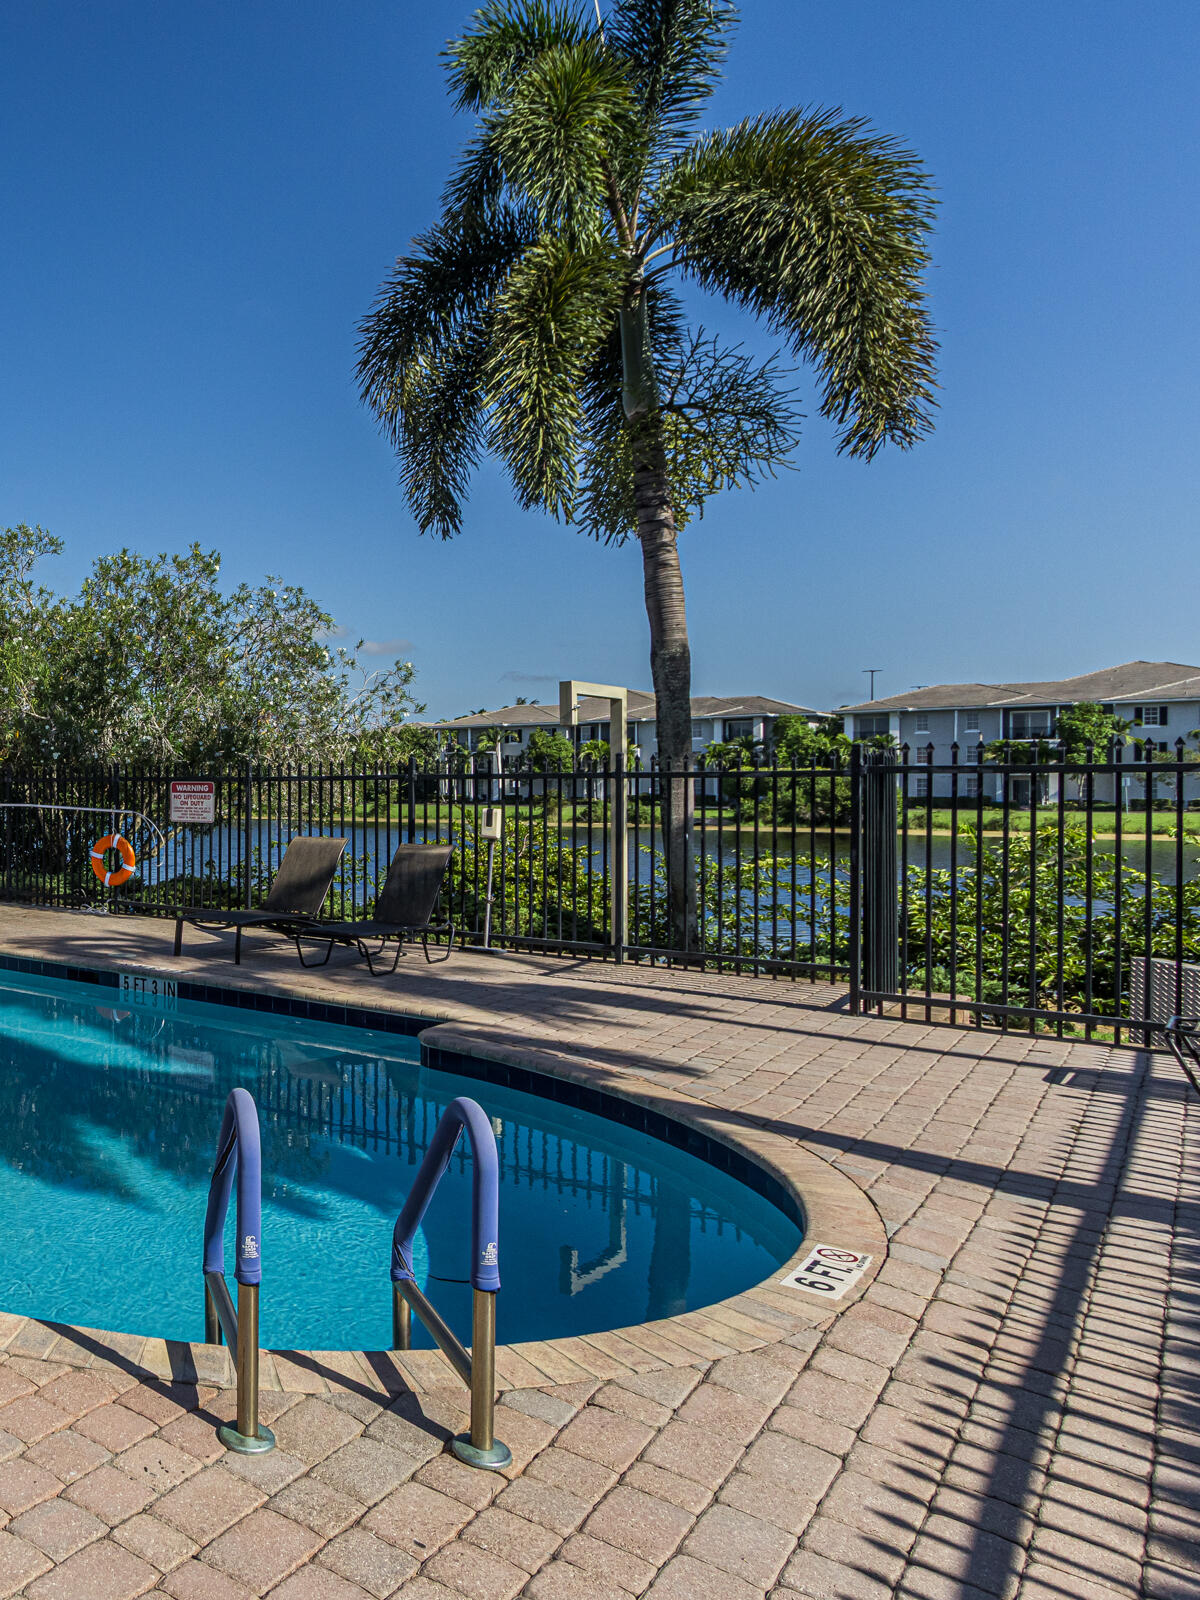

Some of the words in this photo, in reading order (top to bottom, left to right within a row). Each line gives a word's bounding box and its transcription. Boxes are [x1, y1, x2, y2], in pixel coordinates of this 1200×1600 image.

[176, 784, 209, 792] WARNING
[123, 975, 129, 990] 5
[134, 977, 147, 993] FT
[152, 979, 158, 995] 3
[163, 981, 176, 997] IN
[794, 1276, 836, 1292] 6
